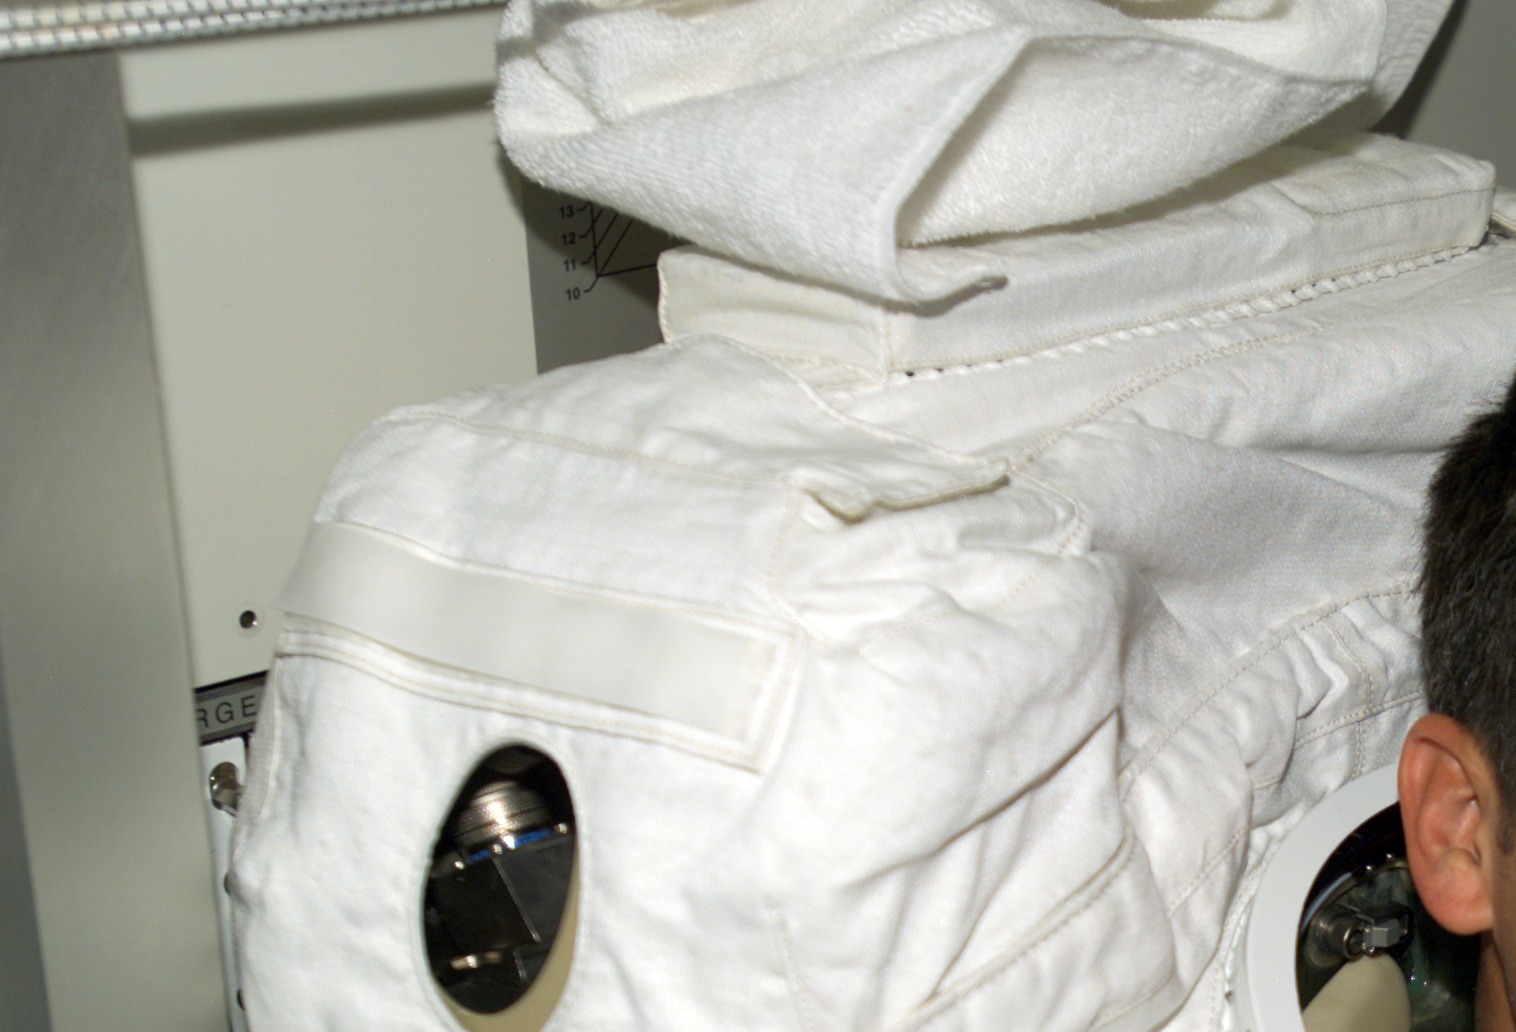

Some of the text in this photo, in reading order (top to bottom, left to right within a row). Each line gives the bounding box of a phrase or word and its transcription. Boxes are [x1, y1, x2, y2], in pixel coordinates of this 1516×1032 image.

[560, 205, 574, 218] 13
[562, 232, 576, 246] 12
[564, 258, 576, 272] 11
[566, 287, 580, 301] 10
